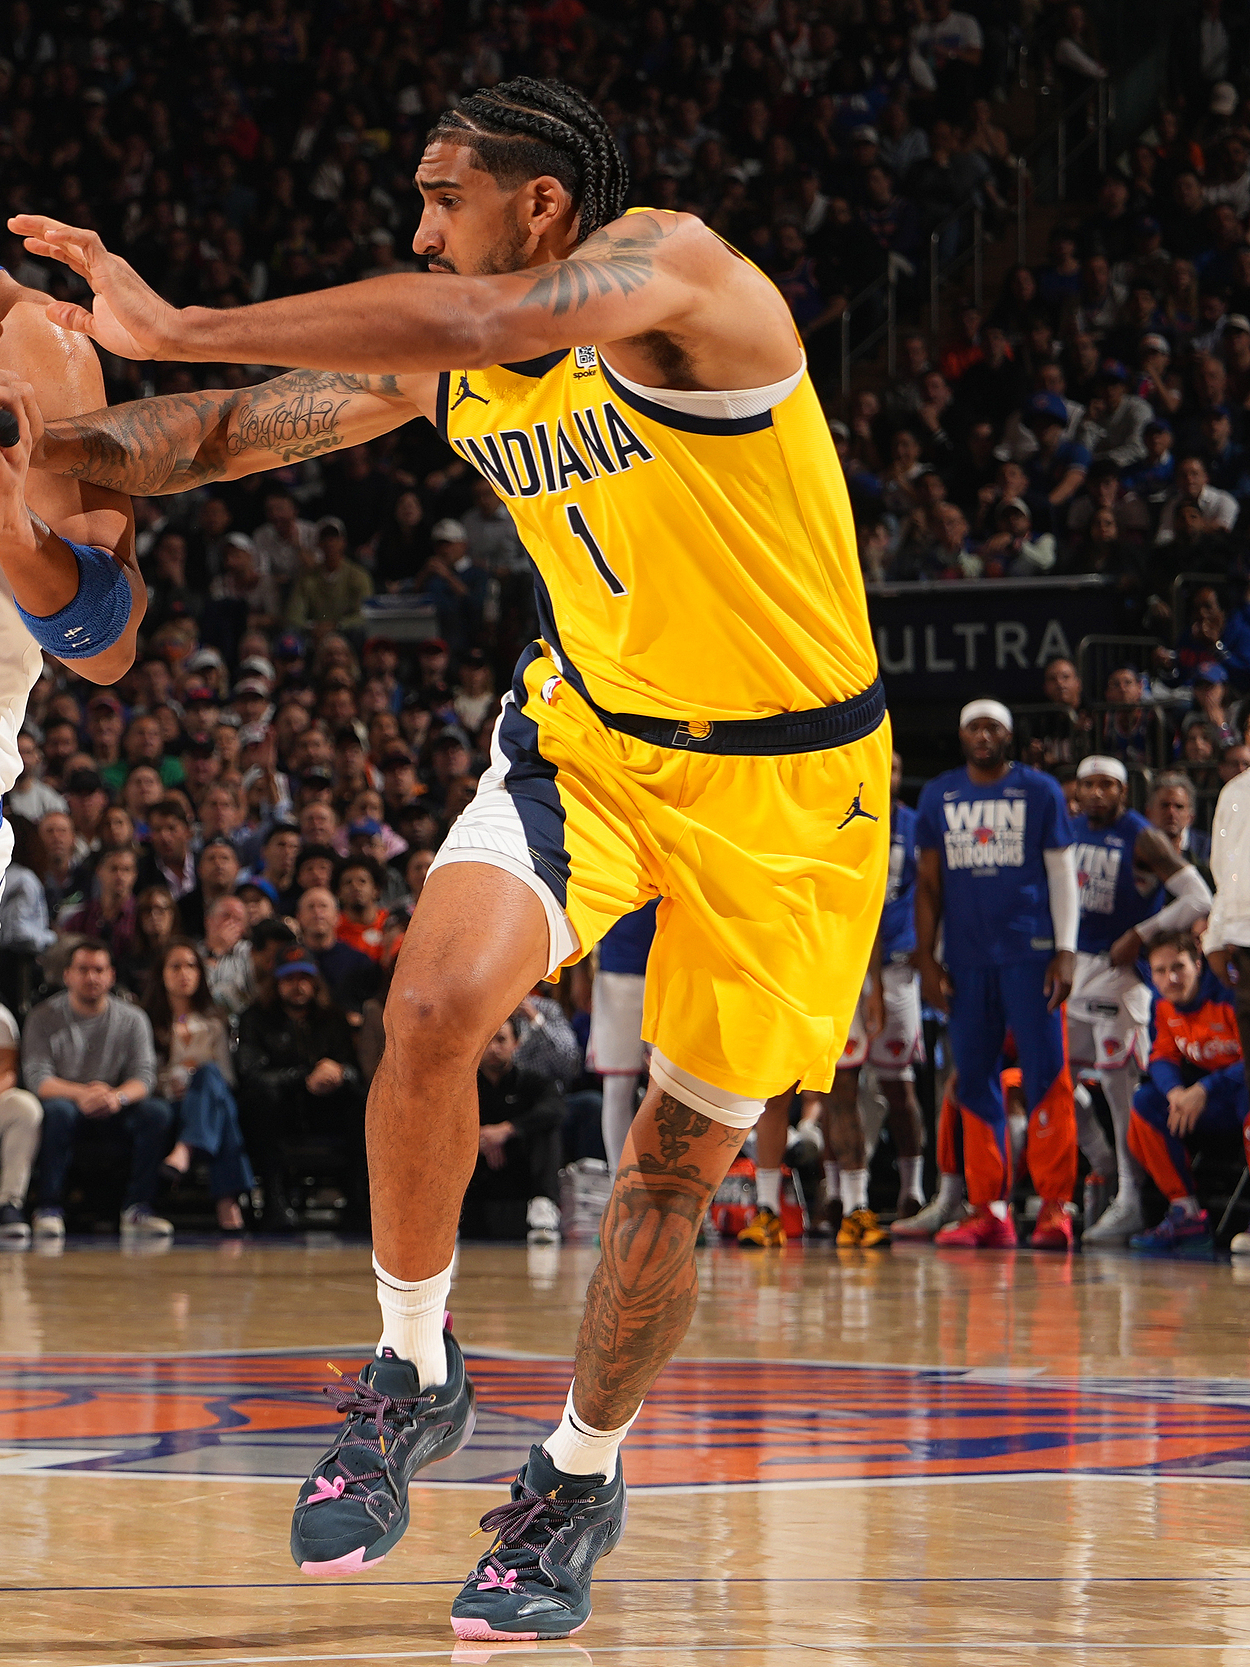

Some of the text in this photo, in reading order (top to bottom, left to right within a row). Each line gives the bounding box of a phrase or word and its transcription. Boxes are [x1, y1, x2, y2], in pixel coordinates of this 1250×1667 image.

[565, 502, 629, 598] 1
[878, 619, 1075, 675] ULTRA
[943, 799, 1027, 832] WIN
